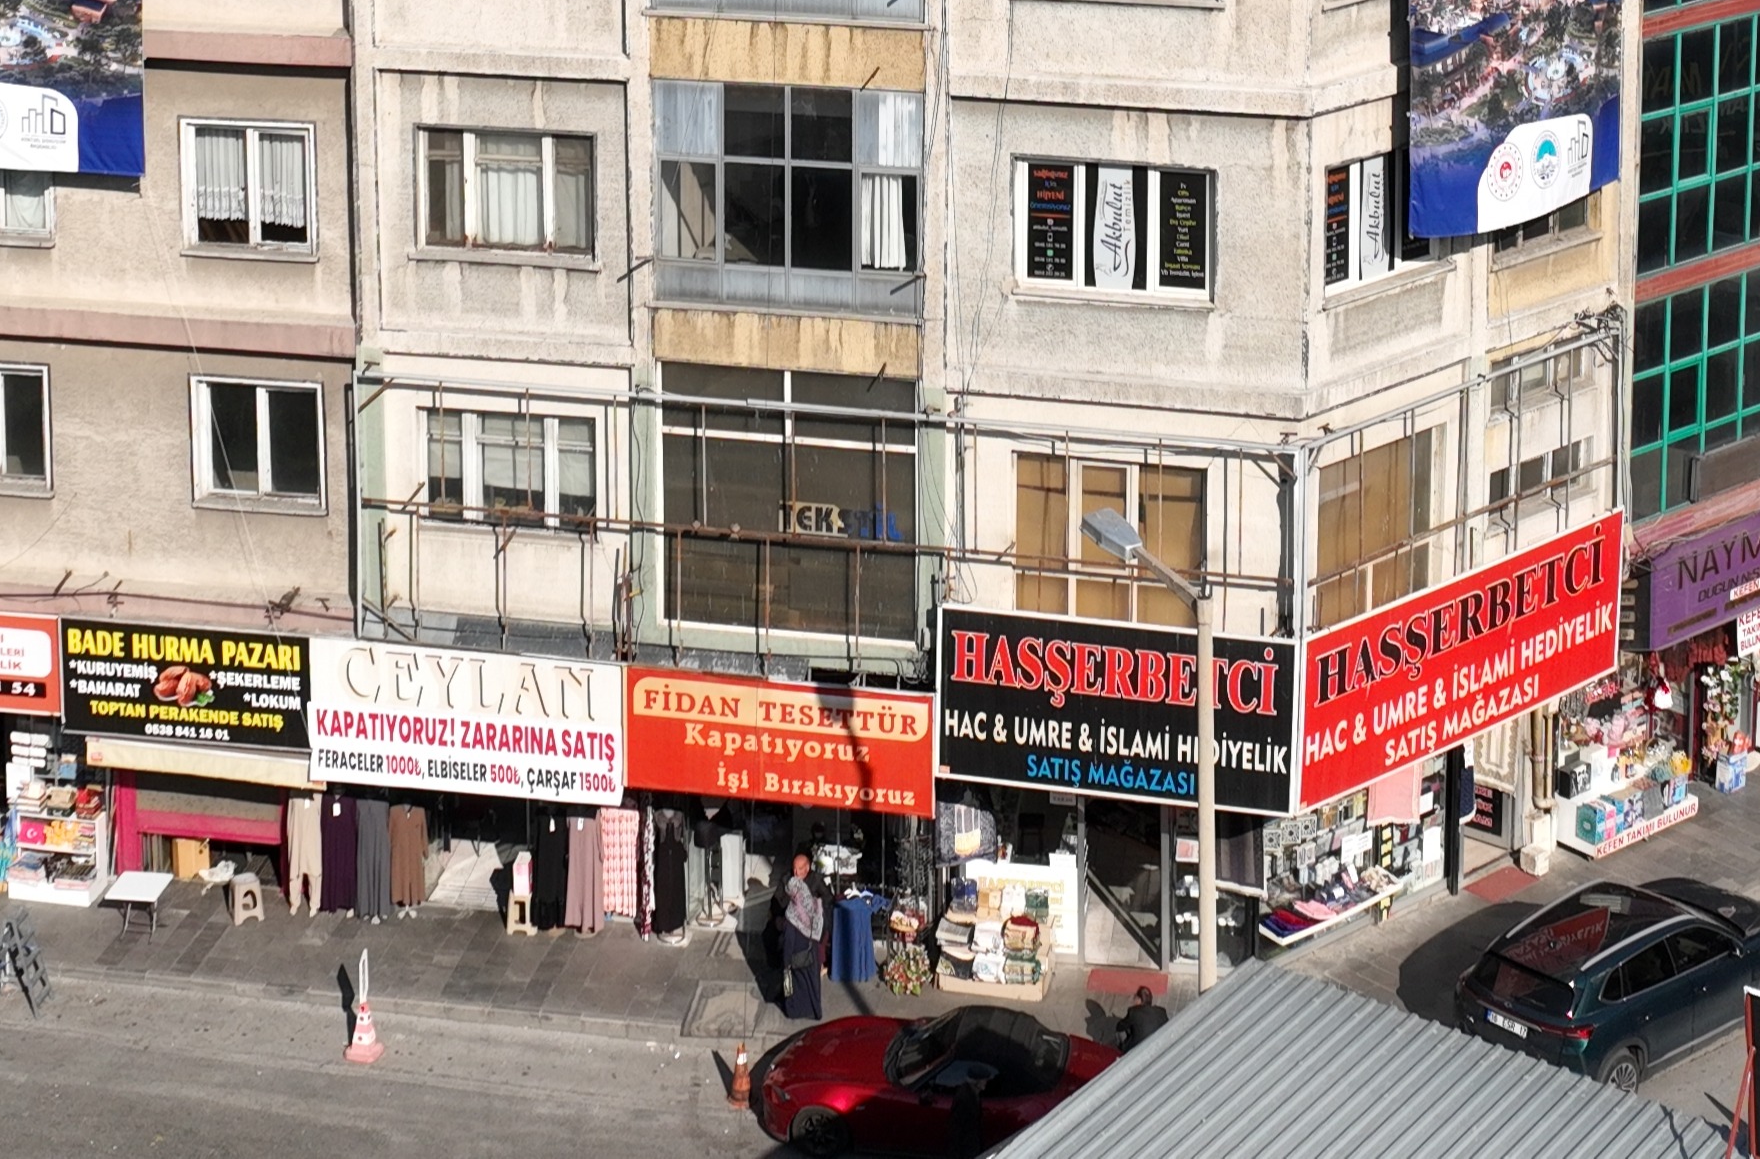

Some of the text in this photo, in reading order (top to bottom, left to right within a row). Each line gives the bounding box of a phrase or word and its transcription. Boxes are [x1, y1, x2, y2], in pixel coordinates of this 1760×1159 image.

[1100, 182, 1123, 272] Akbulut
[1366, 172, 1381, 260] Akbulut
[1732, 579, 1760, 598] KEFEN
[1314, 524, 1606, 709] HASŞERBETCİ
[67, 627, 302, 672] BADE HURMA PAZARI
[951, 629, 1279, 716] HASŞERBETCİ
[10, 681, 36, 697] 54
[76, 660, 302, 691] KURUYEMİŞ ŞEKERLEME
[77, 680, 302, 711] BAHARAT LOKUM
[338, 647, 596, 722] CEYLAN
[1305, 720, 1349, 767] HAC
[1352, 712, 1367, 742] &
[1372, 683, 1428, 735] UMRE
[1432, 677, 1447, 708] &
[1452, 639, 1516, 701] İSLAMİ
[1520, 600, 1614, 671] HEDİYELİK
[89, 699, 284, 732] TOPTAN PERAKENDE SATIŞ
[214, 728, 230, 741] 01
[643, 683, 919, 737] FİDAN TESETTÜR
[1384, 721, 1438, 767] SATIŞ
[1442, 673, 1540, 742] MAĞAZASI
[316, 708, 616, 772] KAPATIYORUZ! ZARARINA SATIŞ
[684, 722, 871, 763] Kapatıyoruz
[944, 709, 987, 740] HAC
[992, 714, 1008, 743] &
[1013, 716, 1073, 750] UMRE
[1078, 723, 1093, 752] &
[1099, 718, 1170, 762] İSLAMİ
[318, 748, 384, 774] FERACELER
[427, 755, 487, 783] ELBİSELER
[526, 767, 577, 796] ÇARŞAF
[716, 761, 916, 806] İşi Bırakıyoruz
[1026, 754, 1196, 797] SATIŞ MAĞAZASI
[1596, 802, 1697, 856] KEFEN TAKIMI BULUNUR
